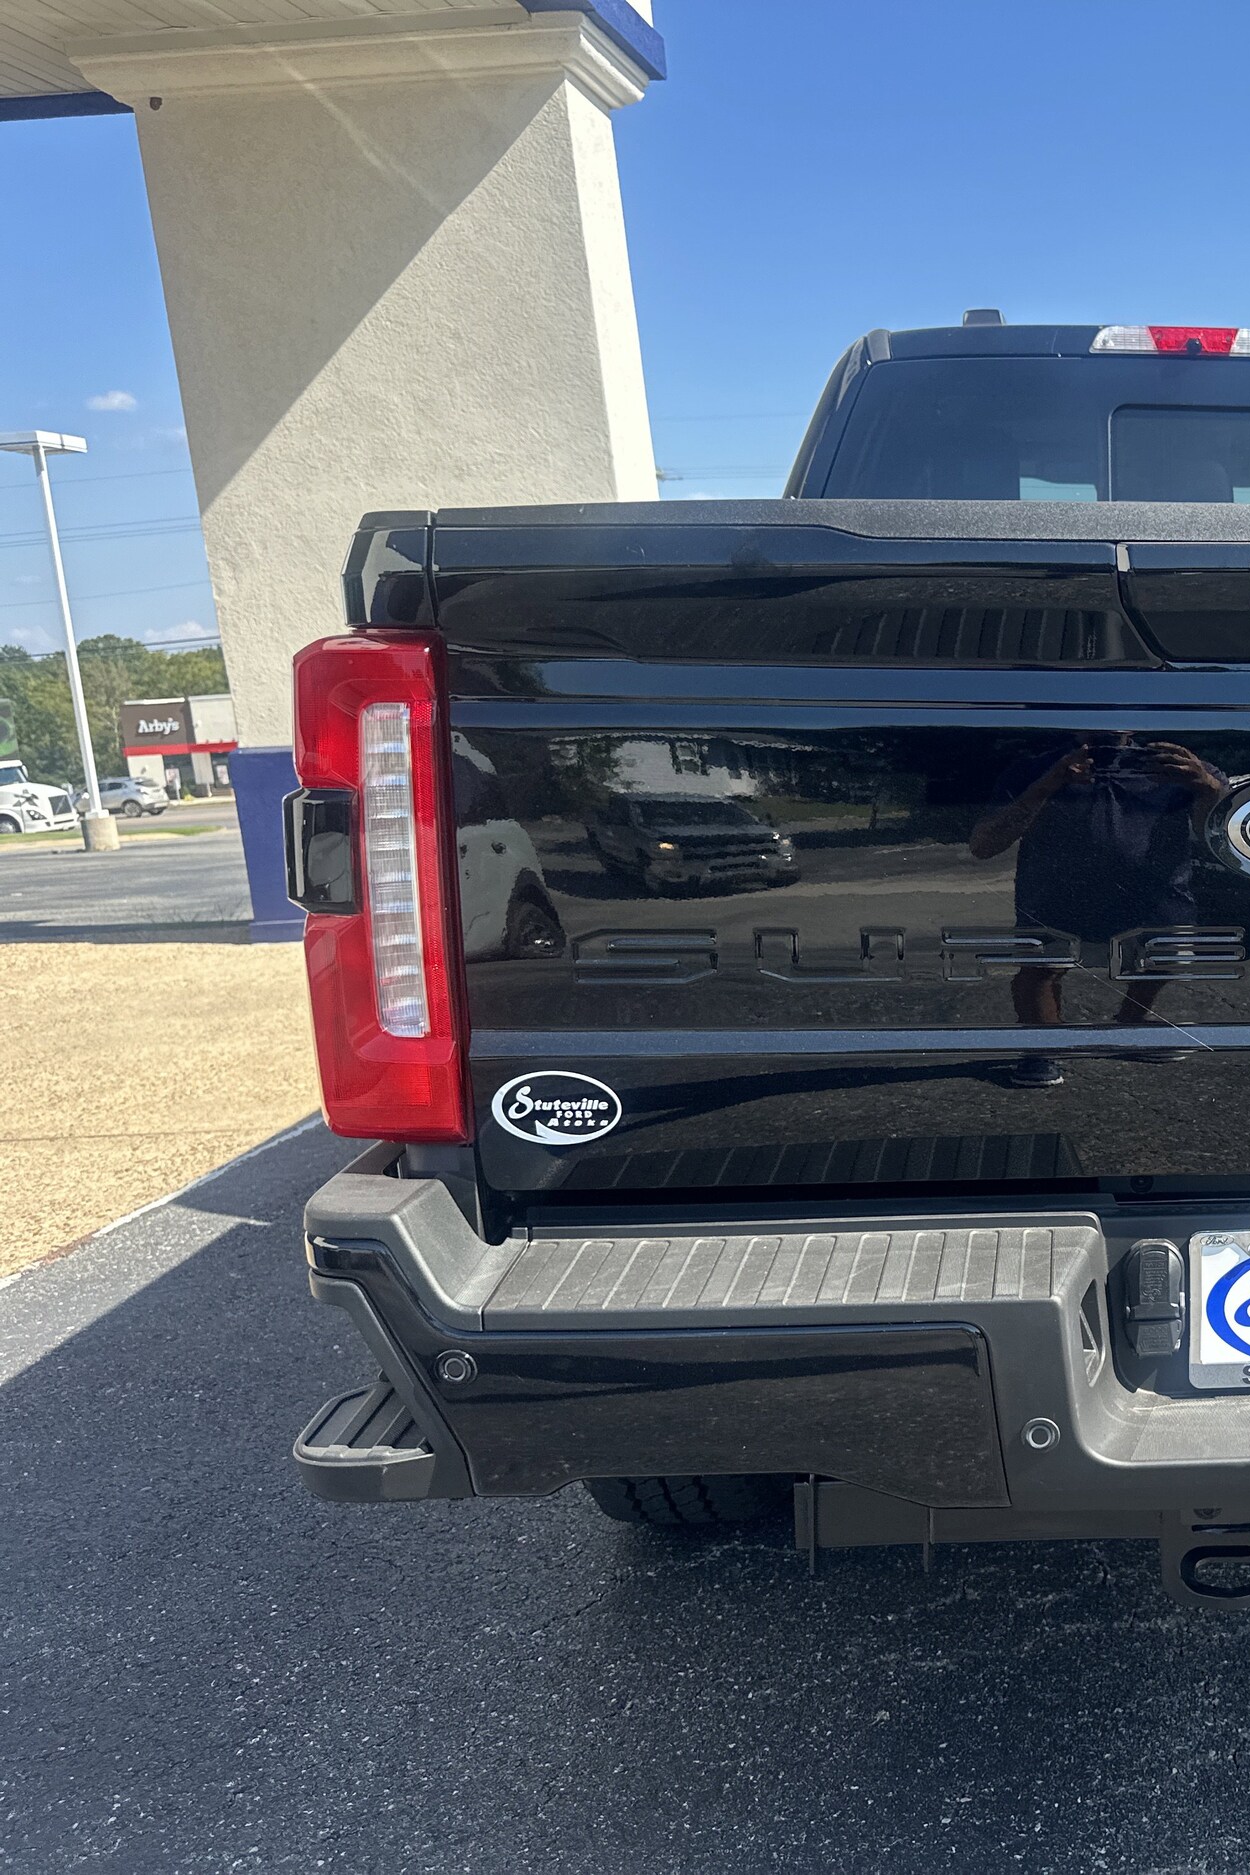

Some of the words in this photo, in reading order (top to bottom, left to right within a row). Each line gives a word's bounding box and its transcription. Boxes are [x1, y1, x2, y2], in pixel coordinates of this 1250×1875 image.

[138, 717, 180, 735] Arby's
[508, 1085, 609, 1119] Stuteville
[556, 1110, 593, 1119] FORD
[547, 1118, 609, 1127] Atoka
[1205, 1235, 1229, 1246] Ford
